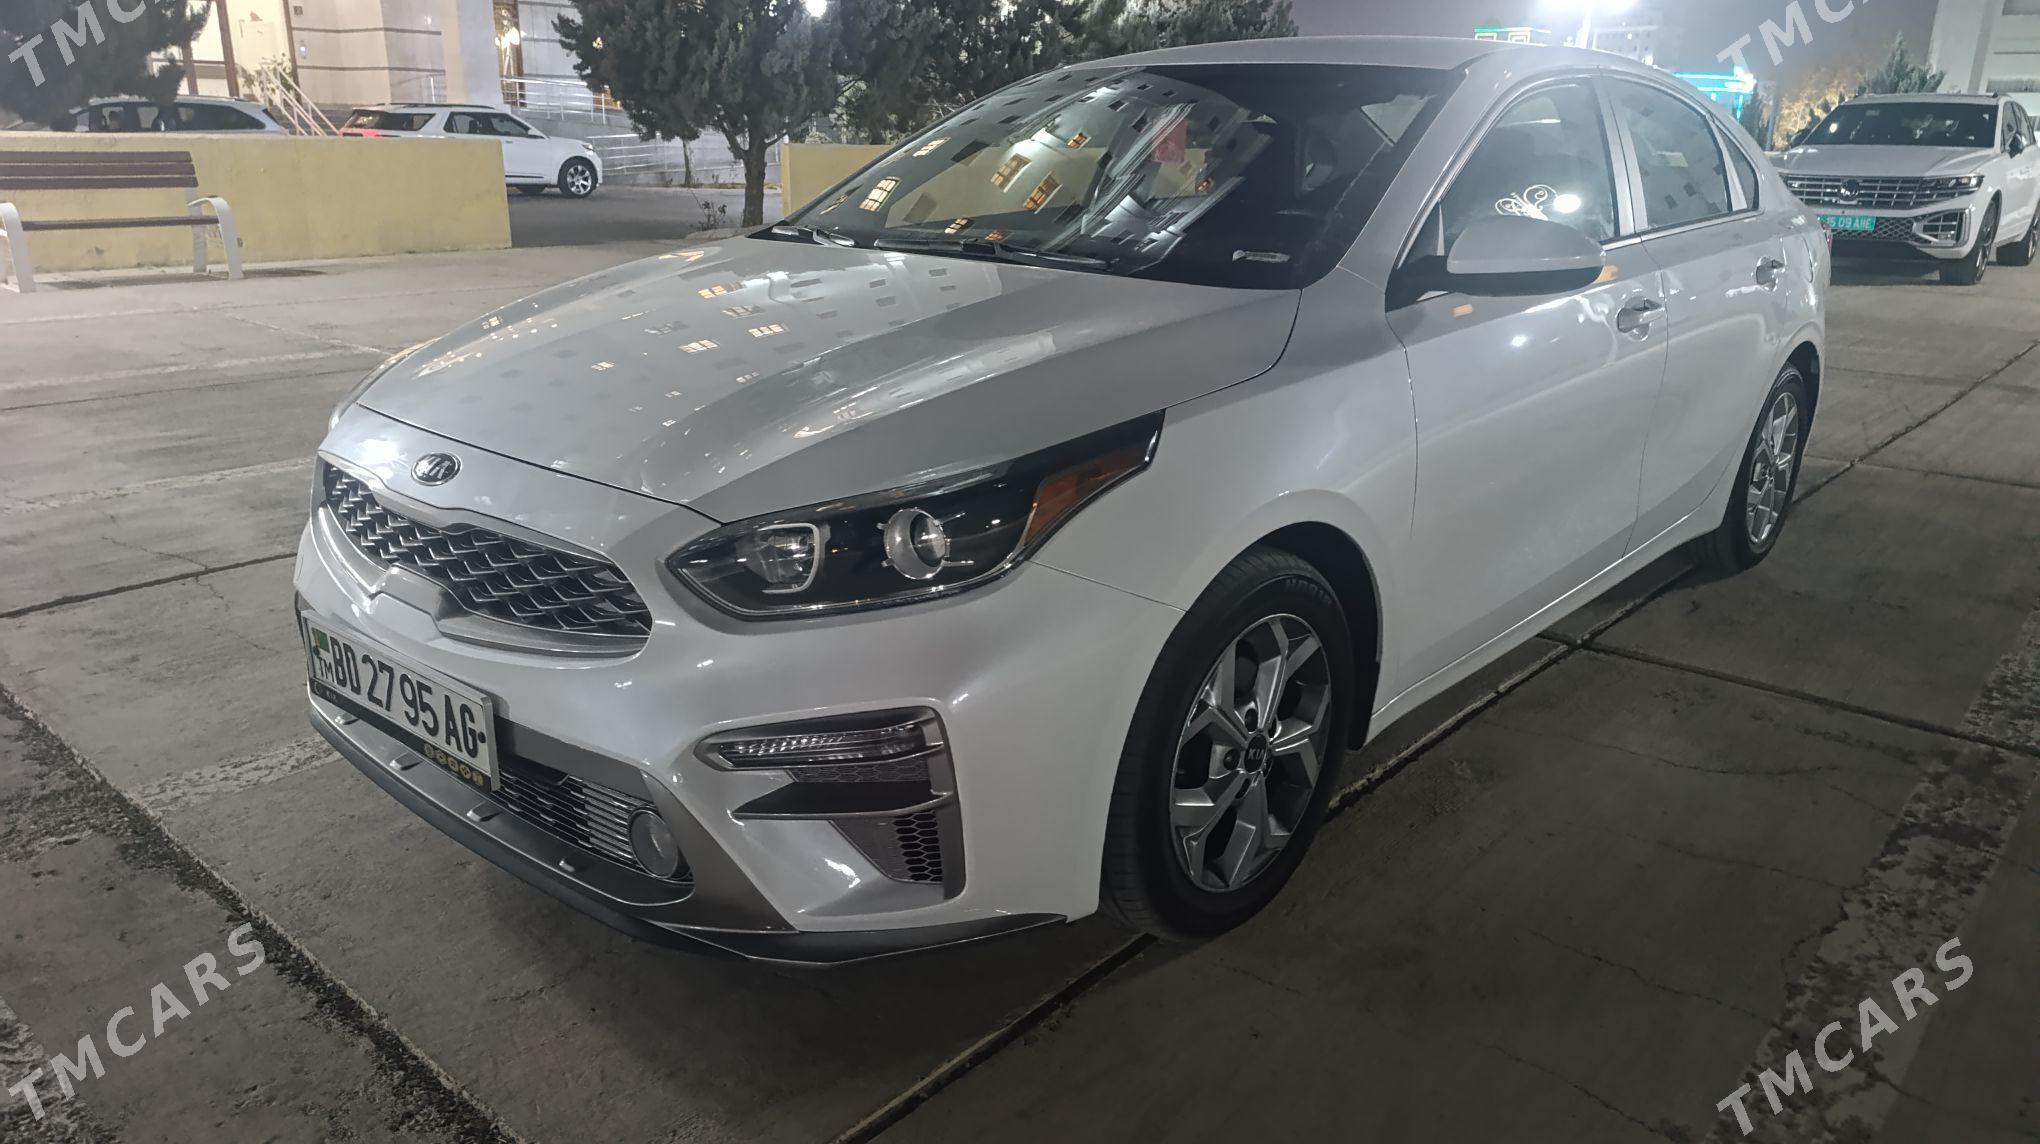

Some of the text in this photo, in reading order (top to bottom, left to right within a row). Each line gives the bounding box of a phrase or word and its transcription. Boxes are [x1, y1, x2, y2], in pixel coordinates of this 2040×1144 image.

[330, 636, 479, 758] BD 27 95 AG
